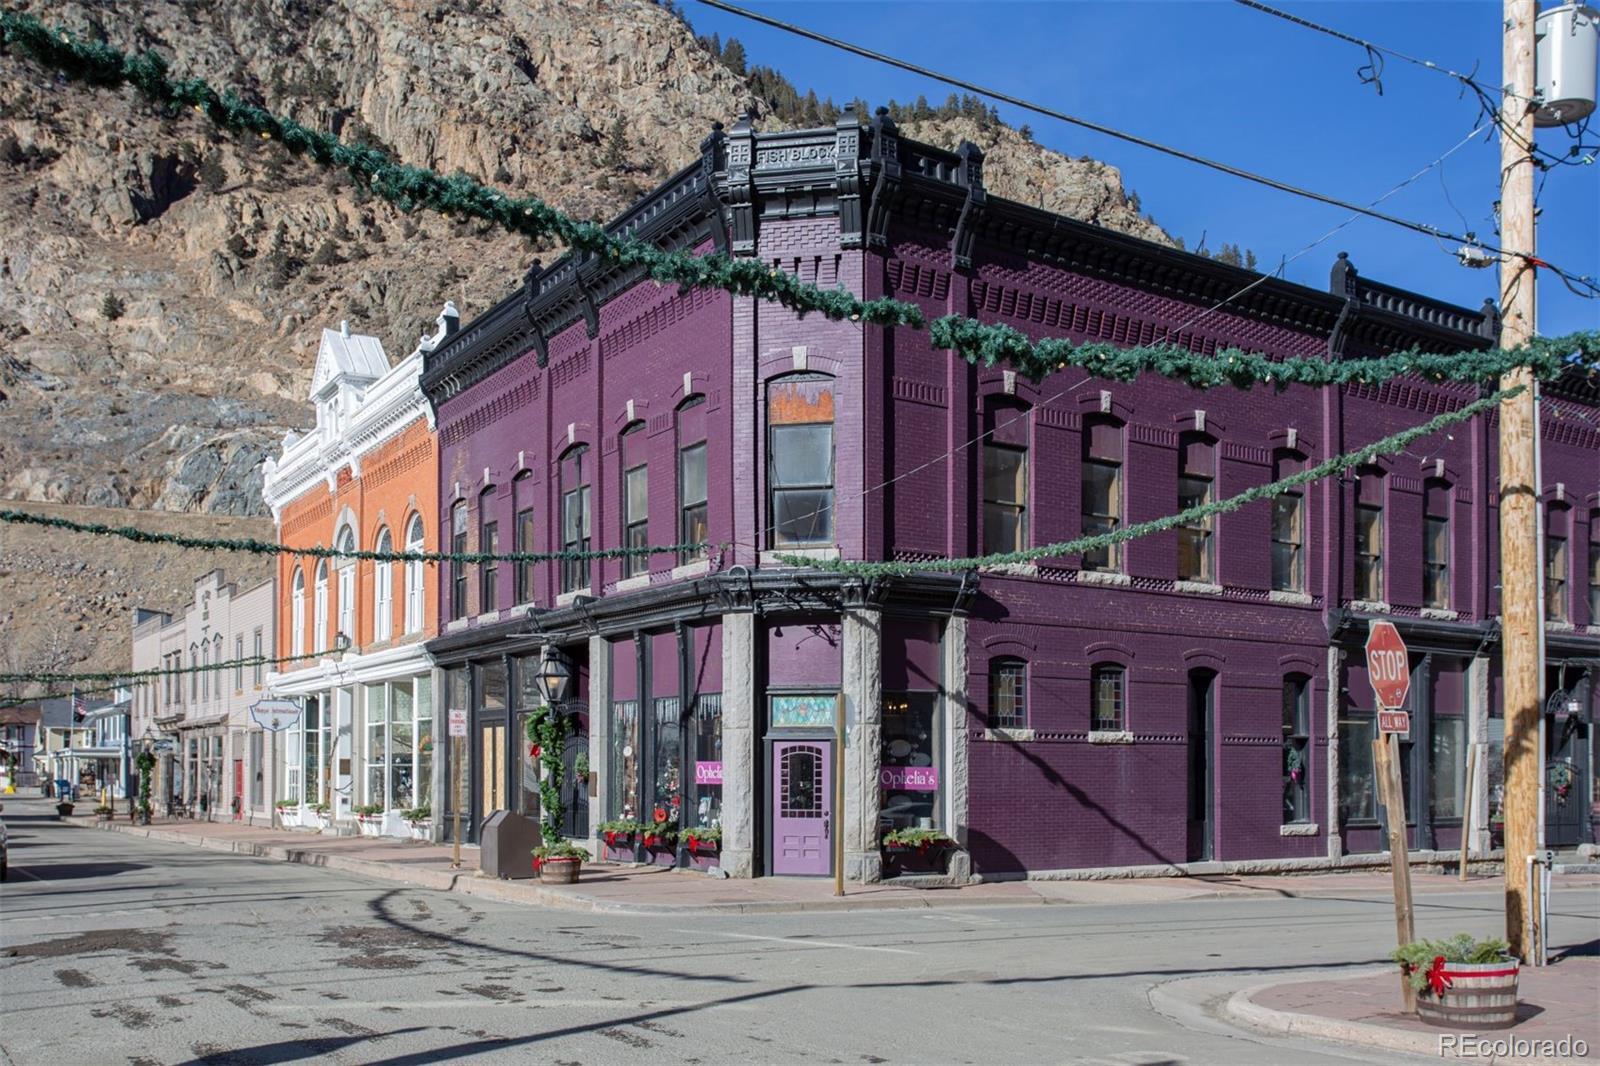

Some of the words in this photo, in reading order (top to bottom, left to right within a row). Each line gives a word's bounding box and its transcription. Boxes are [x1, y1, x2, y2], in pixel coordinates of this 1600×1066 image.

[757, 148, 787, 164] FISH
[791, 145, 835, 161] BLOCK
[1370, 649, 1405, 681] STOP
[1381, 716, 1393, 729] ALL
[1393, 716, 1407, 729] WAY
[881, 770, 935, 788] Ophelia's
